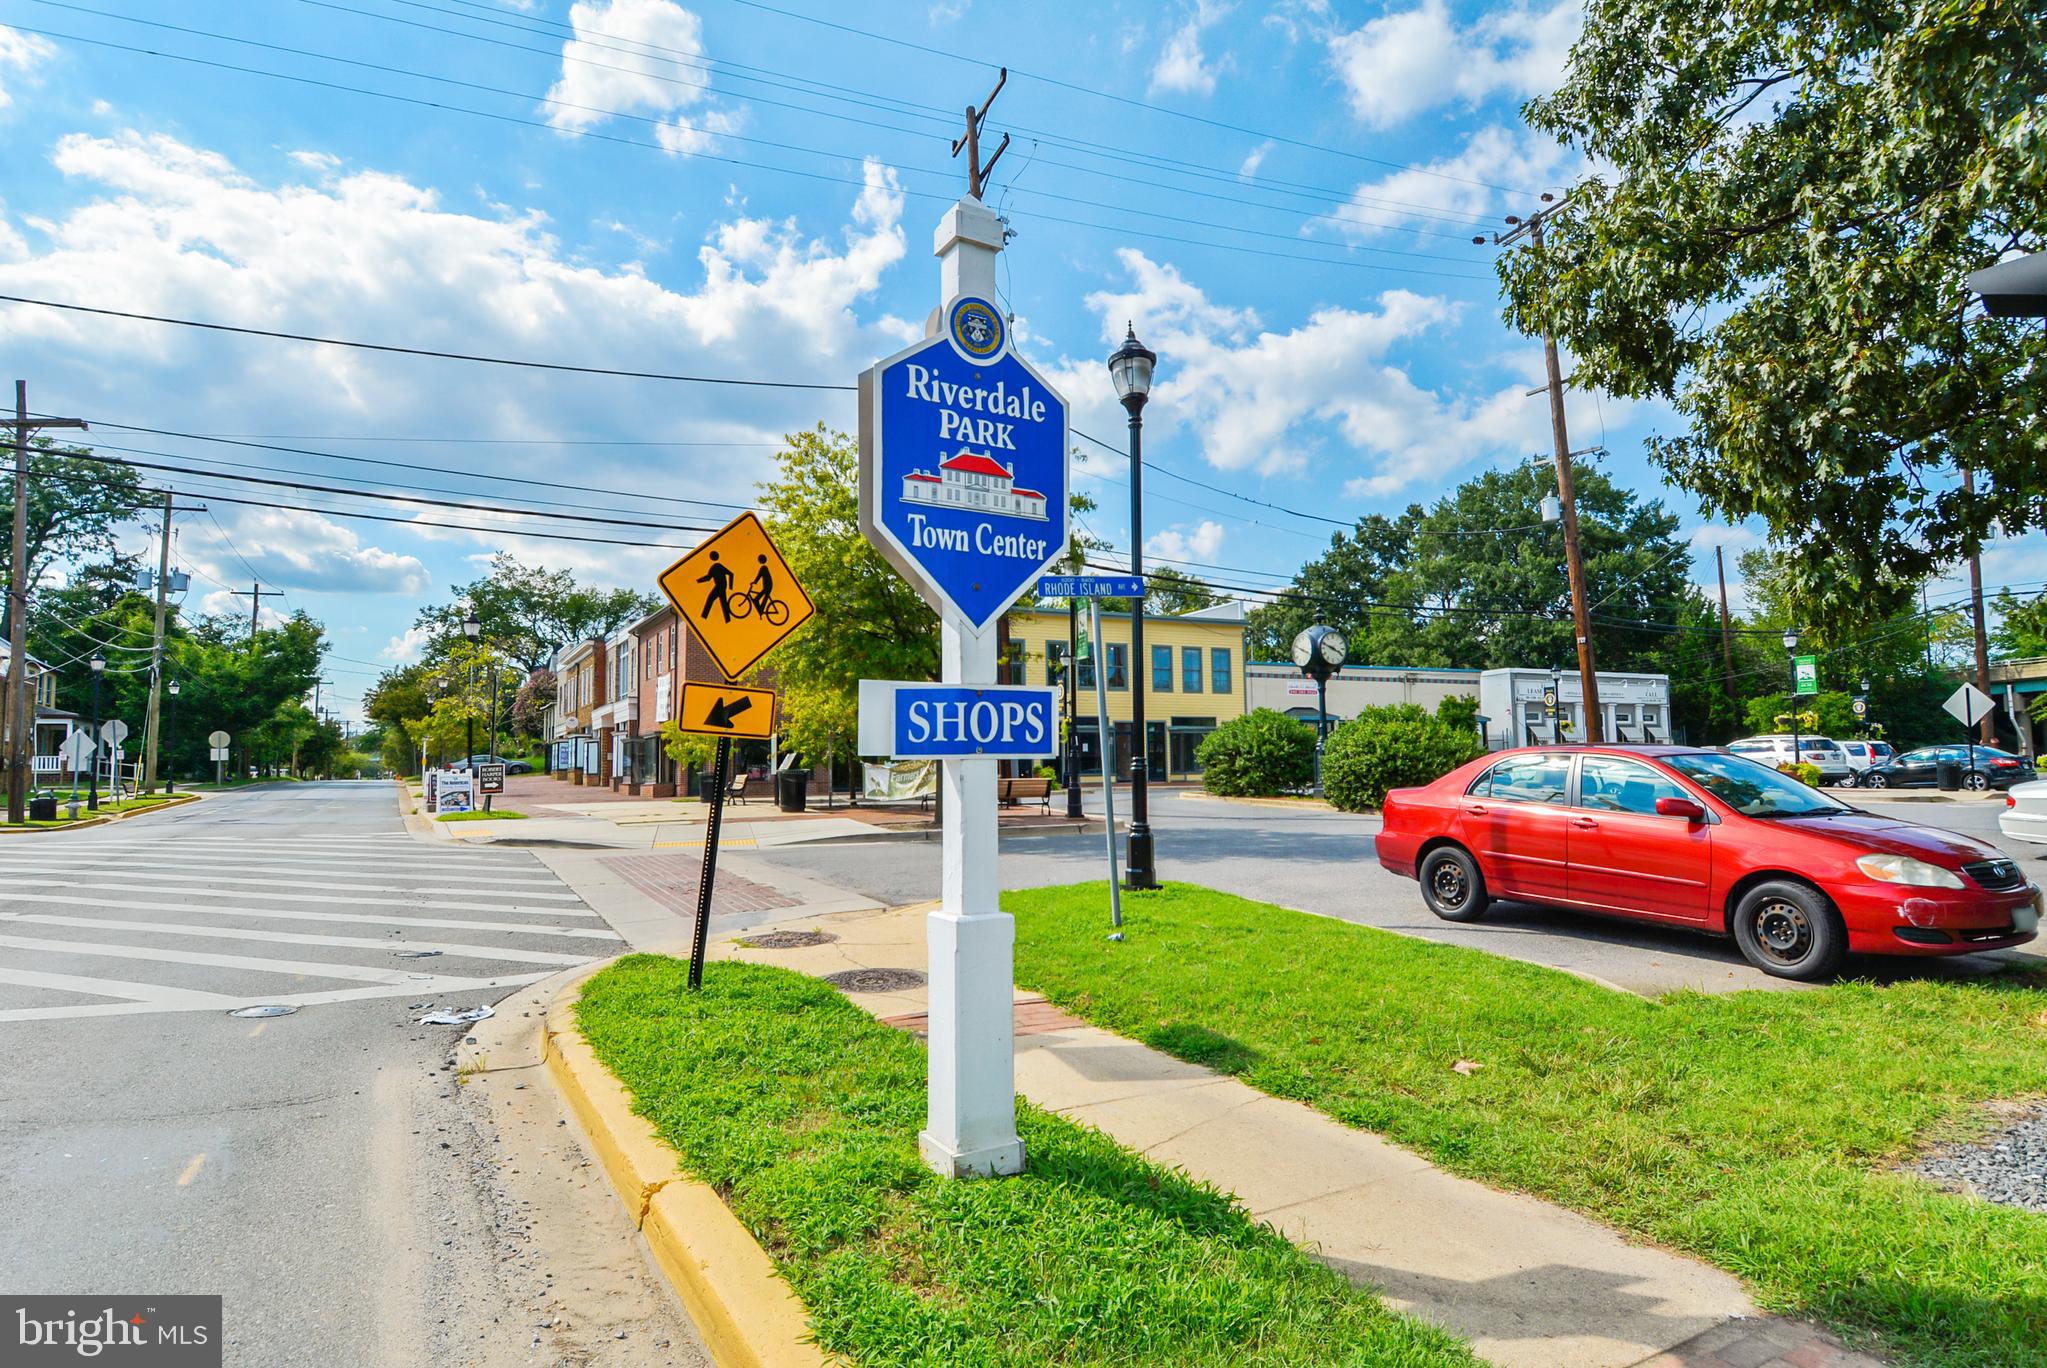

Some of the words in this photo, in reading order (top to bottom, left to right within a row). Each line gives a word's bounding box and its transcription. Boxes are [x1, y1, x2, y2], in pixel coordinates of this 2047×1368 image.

[906, 364, 1046, 423] Riverdale
[939, 409, 1016, 450] PARK
[907, 513, 970, 552] Town
[975, 522, 1047, 561] Center
[1044, 582, 1076, 596] RHODE
[1080, 582, 1113, 596] ISLAND
[908, 700, 1044, 744] SHOPS
